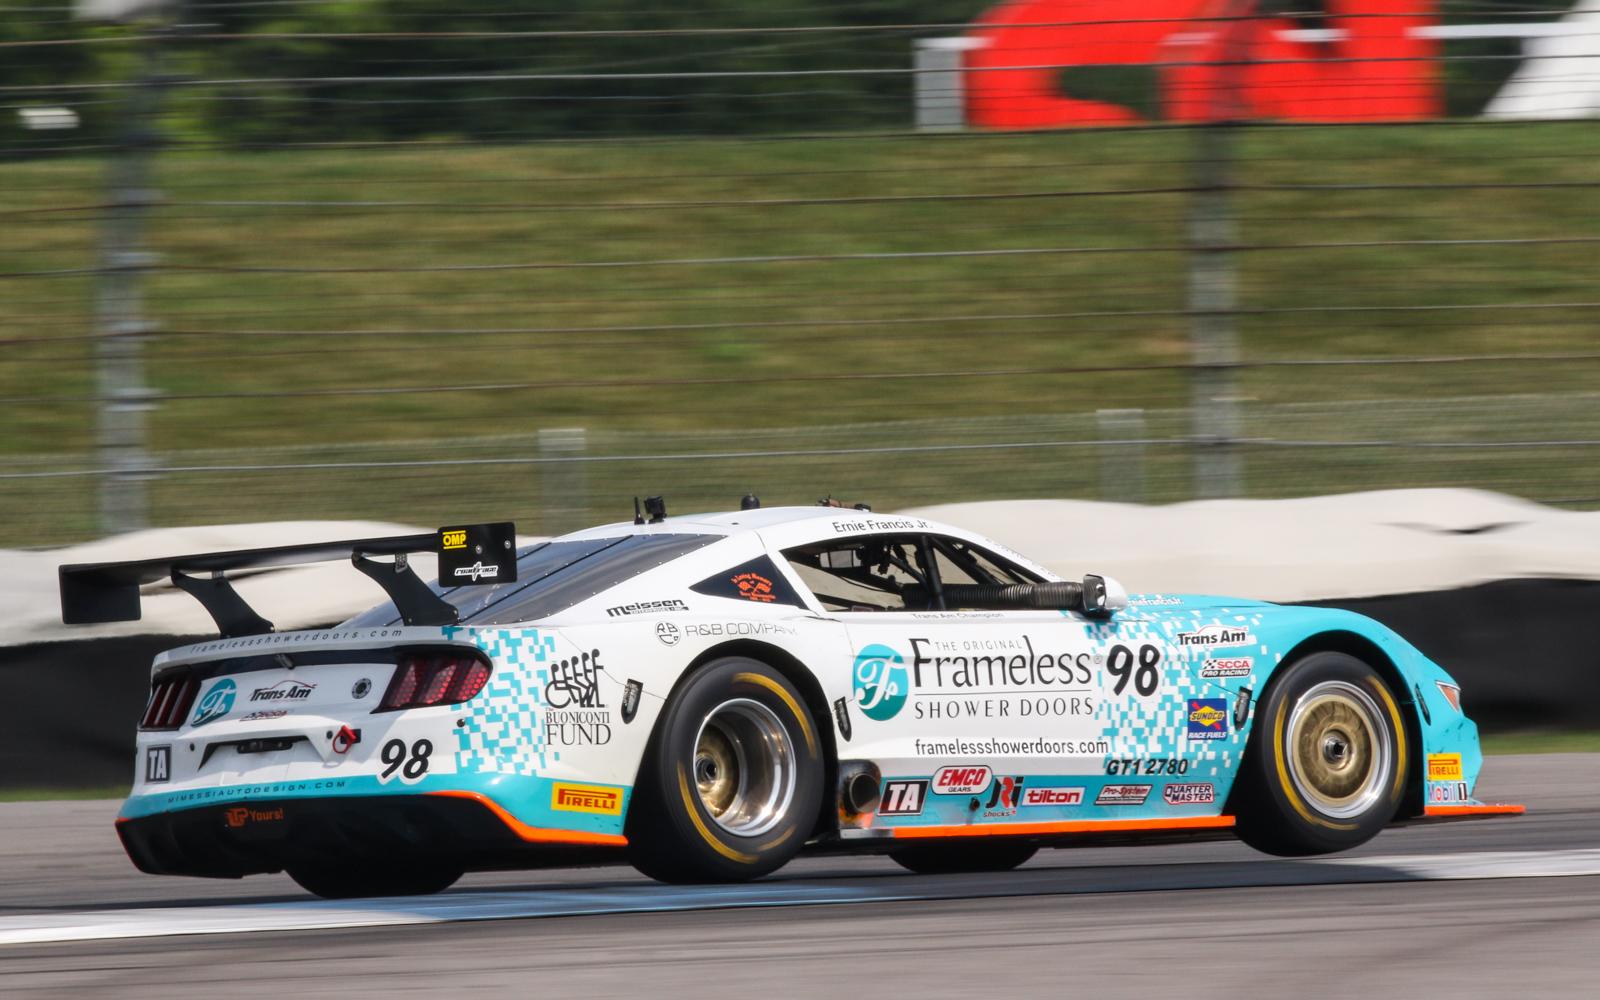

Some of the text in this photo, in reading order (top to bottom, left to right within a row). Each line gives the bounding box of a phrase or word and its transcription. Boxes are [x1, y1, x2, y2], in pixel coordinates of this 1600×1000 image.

[832, 519, 933, 532] Ernie Francis Jr.
[443, 533, 467, 546] OMP
[685, 624, 723, 637] R&B
[1177, 630, 1246, 645] Trans Am
[190, 629, 403, 653] framelessshowerdoors.com
[935, 639, 1022, 651] THE ORIGINAL
[908, 635, 1092, 688] Frameless
[1217, 660, 1250, 669] SCCA
[1106, 644, 1160, 697] 98
[250, 685, 311, 702] Trans Am
[915, 697, 1093, 719] SHOWER DOORS
[1191, 712, 1223, 720] SUNOCO
[546, 711, 610, 724] BUONICONTI
[546, 723, 611, 745] FUND
[915, 738, 1109, 756] framelessshowerdoors.com
[149, 749, 167, 781] TA
[381, 738, 433, 779] 98
[1106, 758, 1188, 775] GT1 2780
[1428, 759, 1459, 775] PIRELLI
[938, 769, 986, 787] EMCO
[557, 788, 617, 810] PIRELLI
[888, 783, 919, 812] TA
[1027, 790, 1080, 804] tilton
[1102, 787, 1148, 797] Pro-System
[1165, 785, 1211, 797] QUARTER
[1171, 793, 1212, 802] MASTER
[1429, 782, 1455, 801] Mobil
[249, 808, 284, 822] Yours!
